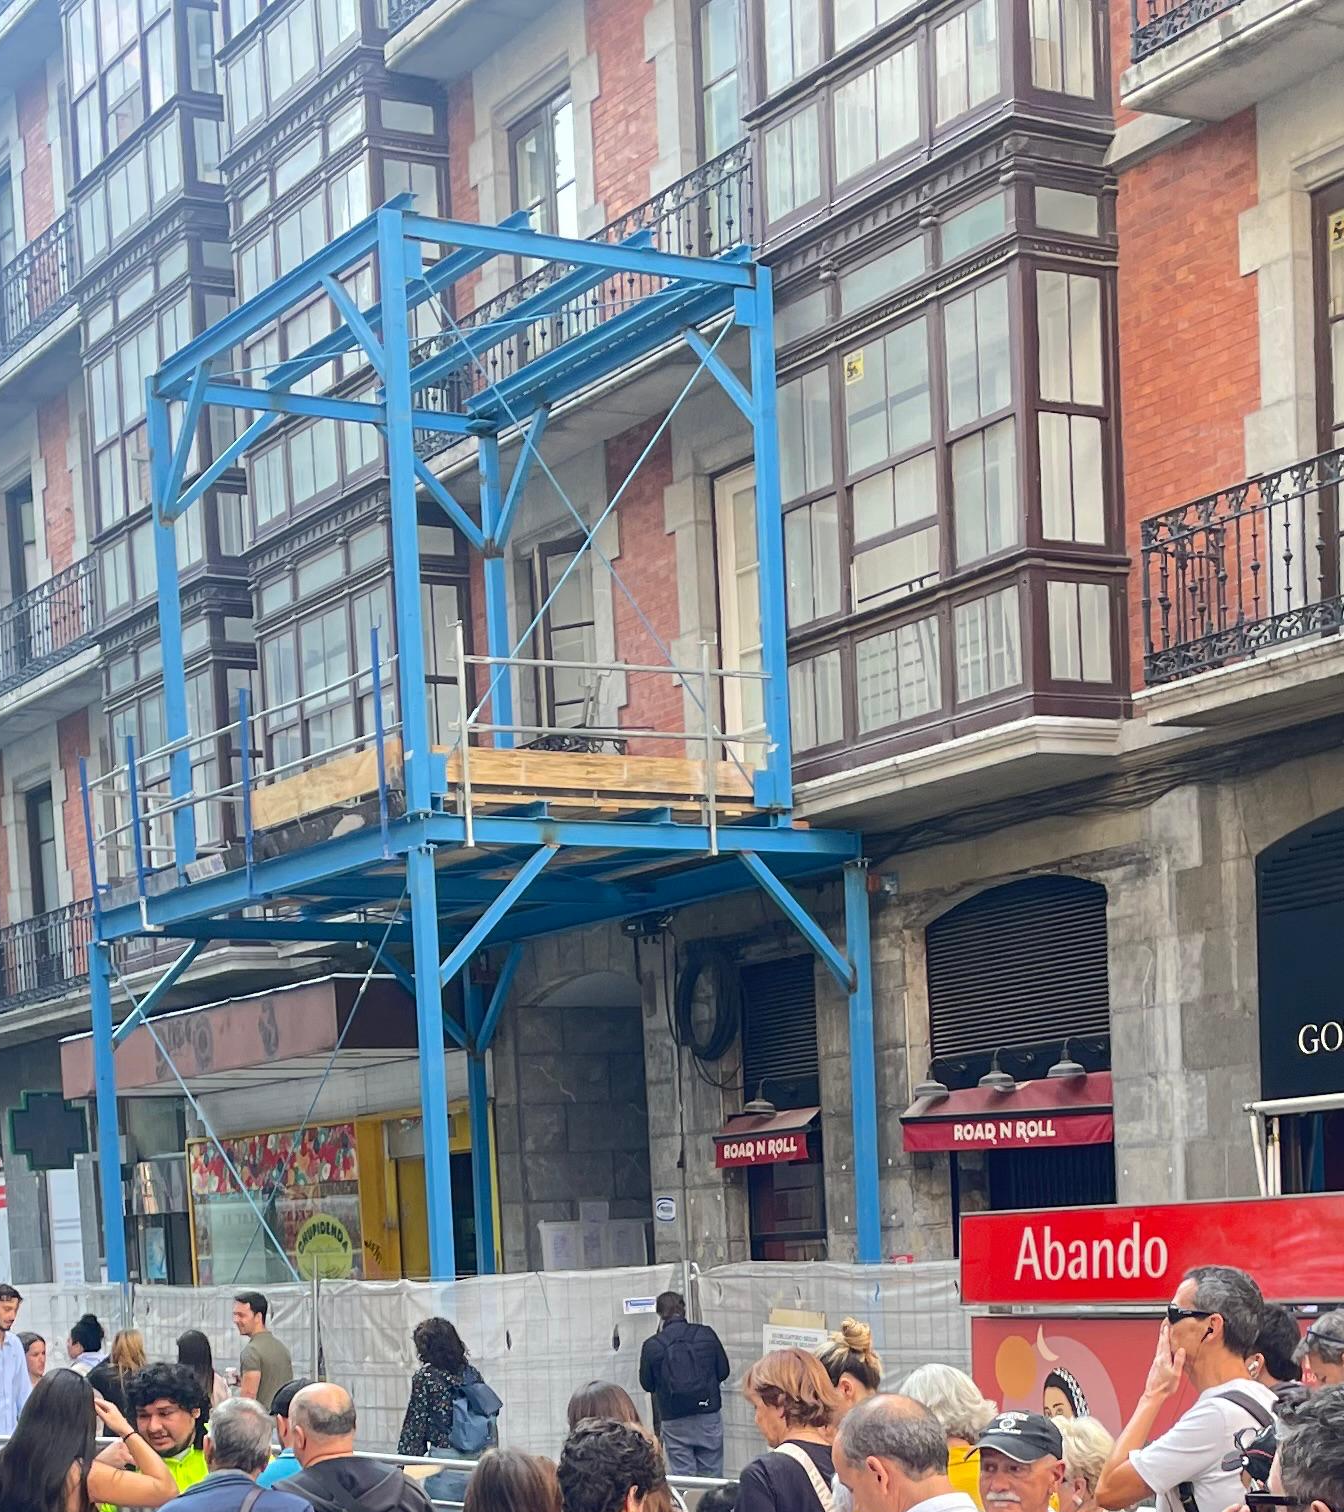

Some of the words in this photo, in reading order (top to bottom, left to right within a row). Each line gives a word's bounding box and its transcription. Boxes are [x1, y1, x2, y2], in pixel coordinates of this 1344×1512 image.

[954, 1123, 997, 1145] ROAD
[999, 1121, 1012, 1139] N
[1016, 1119, 1056, 1144] ROLL
[723, 1142, 755, 1162] ROAD
[757, 1140, 765, 1156] N
[768, 1136, 798, 1159] ROLL
[1014, 1221, 1168, 1281] Abando
